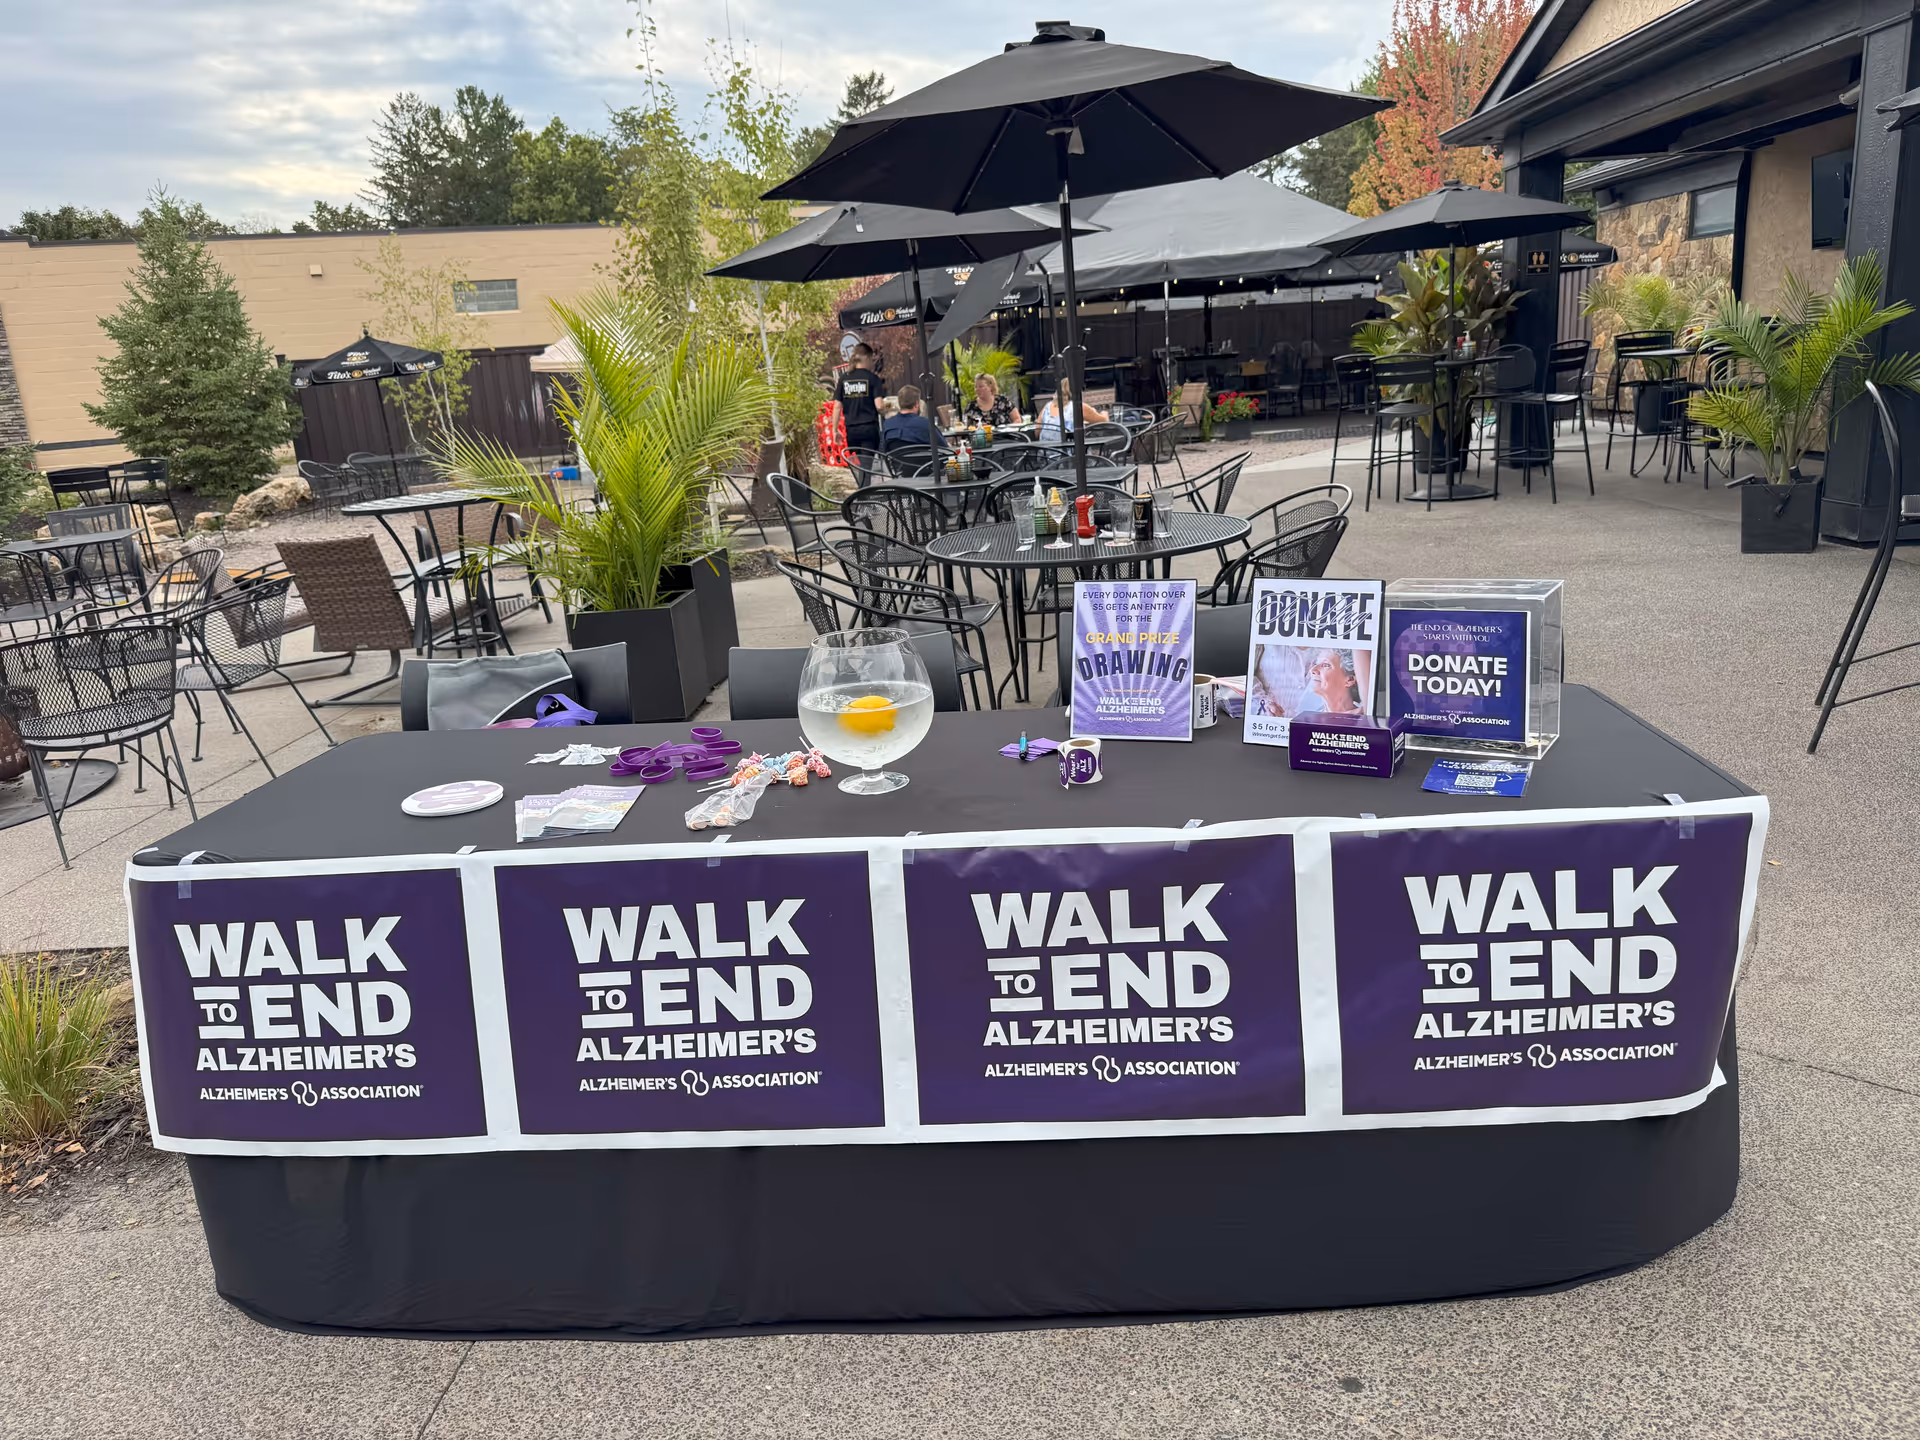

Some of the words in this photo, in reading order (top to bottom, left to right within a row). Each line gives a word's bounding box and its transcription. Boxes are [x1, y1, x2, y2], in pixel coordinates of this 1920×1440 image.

[860, 309, 885, 325] Tito's
[327, 370, 352, 380] Tito's
[1083, 591, 1111, 599] EVERY
[1112, 591, 1160, 599] DONATION
[1161, 590, 1186, 599] OVER
[1092, 603, 1104, 611] $5
[1105, 603, 1129, 611] GETS
[1130, 603, 1143, 611] AN
[1144, 602, 1175, 611] ENTRY
[1115, 615, 1133, 623] FOR
[1134, 614, 1152, 623] THE
[1258, 590, 1374, 641] DONATE
[1410, 623, 1423, 631] THE
[1424, 624, 1441, 632] END
[1455, 625, 1503, 634] ALZHEIMER'S
[1085, 632, 1136, 644] GRAND
[1139, 632, 1180, 644] PRIZE
[1451, 634, 1473, 642] WITH
[1472, 635, 1491, 643] YOU
[1078, 650, 1188, 683] DRAWING
[1408, 653, 1508, 676] DONATE
[1412, 675, 1502, 698] TODAY!
[1095, 705, 1166, 715] ALZHEIMER'S
[1099, 696, 1130, 706] WALK
[1139, 697, 1163, 707] END
[1252, 722, 1264, 731] $5
[1265, 723, 1278, 732] for
[1279, 725, 1286, 733] 3
[1403, 712, 1448, 722] ALZHEIMER'S
[1461, 716, 1510, 726] ASSOCIATION
[1308, 739, 1370, 750] ALZHEIMER'S
[1311, 731, 1339, 740] WALK
[1346, 735, 1366, 743] END
[1404, 866, 1678, 934] WALK
[971, 883, 1231, 949] WALK
[563, 899, 809, 963] WALK
[174, 916, 406, 977] WALK
[1428, 963, 1472, 984] TO
[1490, 936, 1676, 1003] END
[994, 974, 1035, 994] TO
[1051, 951, 1230, 1010] END
[586, 989, 626, 1010] TO
[642, 965, 812, 1026] END
[201, 1003, 237, 1022] TO
[249, 981, 411, 1039] END
[1414, 998, 1674, 1038] ALZHEIMER'S
[984, 1016, 1233, 1046] ALZHEIMER'S
[577, 1027, 816, 1061] ALZHEIMER'S
[197, 1044, 416, 1070] ALZHEIMER'S
[1415, 1052, 1522, 1070] ALZHEIMER'S
[985, 1063, 1088, 1077] ALZHEIMER'S
[580, 1078, 677, 1091] ALZHEIMER'S
[200, 1088, 288, 1100] ALZHEIMER'S
